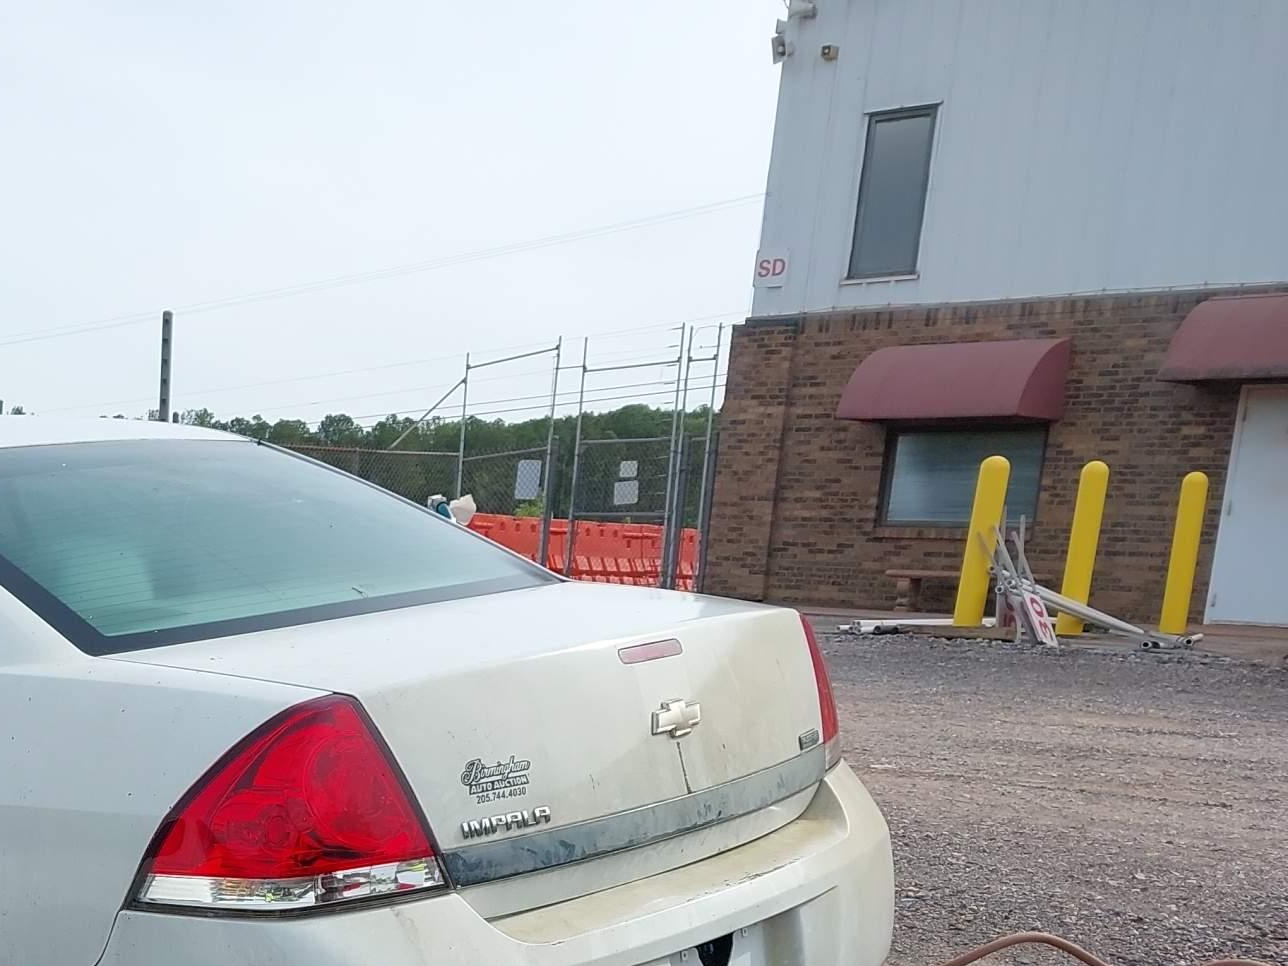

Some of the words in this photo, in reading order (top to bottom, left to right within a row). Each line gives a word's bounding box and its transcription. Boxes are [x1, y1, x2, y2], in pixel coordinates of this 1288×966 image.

[758, 258, 786, 278] SD
[461, 755, 531, 787] Birmingham
[470, 782, 493, 794] AUTO
[493, 775, 529, 789] AUCTION
[476, 786, 527, 804] 205.744.4030
[461, 806, 551, 839] IMPALA
